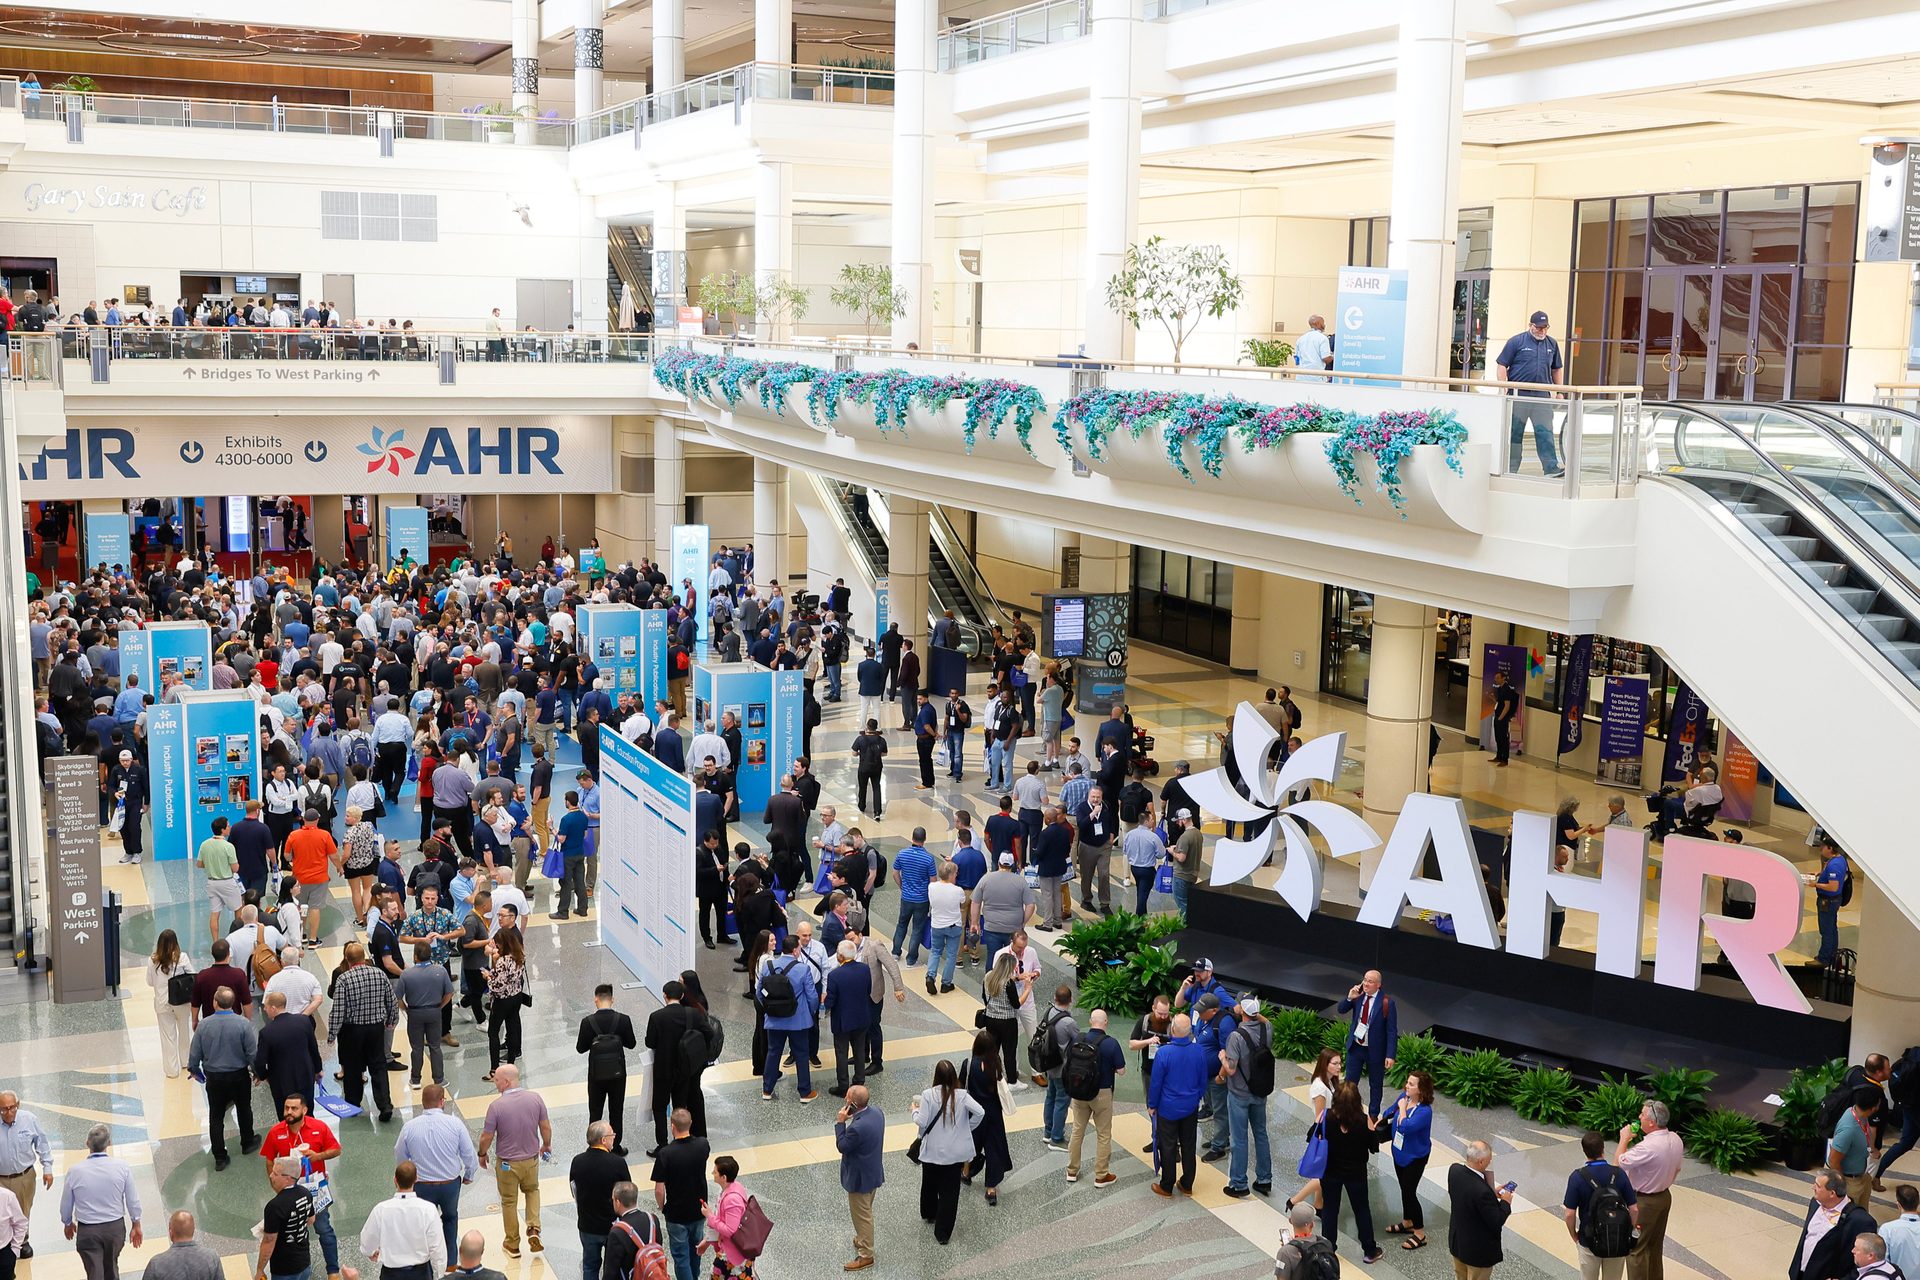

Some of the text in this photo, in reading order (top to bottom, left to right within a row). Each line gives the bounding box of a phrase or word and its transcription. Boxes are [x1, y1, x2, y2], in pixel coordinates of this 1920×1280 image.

[24, 183, 207, 217] Gary Sain Café
[1354, 277, 1380, 289] AHR
[201, 368, 363, 383] Bridges To West Parking
[225, 436, 282, 448] Exhibits
[414, 427, 564, 474] AHR
[215, 453, 293, 465] 4300-6000
[124, 643, 143, 651] AHR
[780, 684, 798, 692] AHR
[1624, 693, 1640, 701] Pickup
[153, 720, 177, 730] AHR
[1567, 705, 1579, 743] FedEx
[1675, 720, 1697, 772] FedEx
[163, 745, 172, 777] Industry
[616, 744, 636, 765] Education
[635, 756, 650, 776] Program
[57, 763, 85, 771] Skybridge
[164, 779, 174, 829] Publications
[1355, 791, 1814, 1017] AHR
[64, 907, 97, 919] West
[63, 920, 99, 930] Parking
